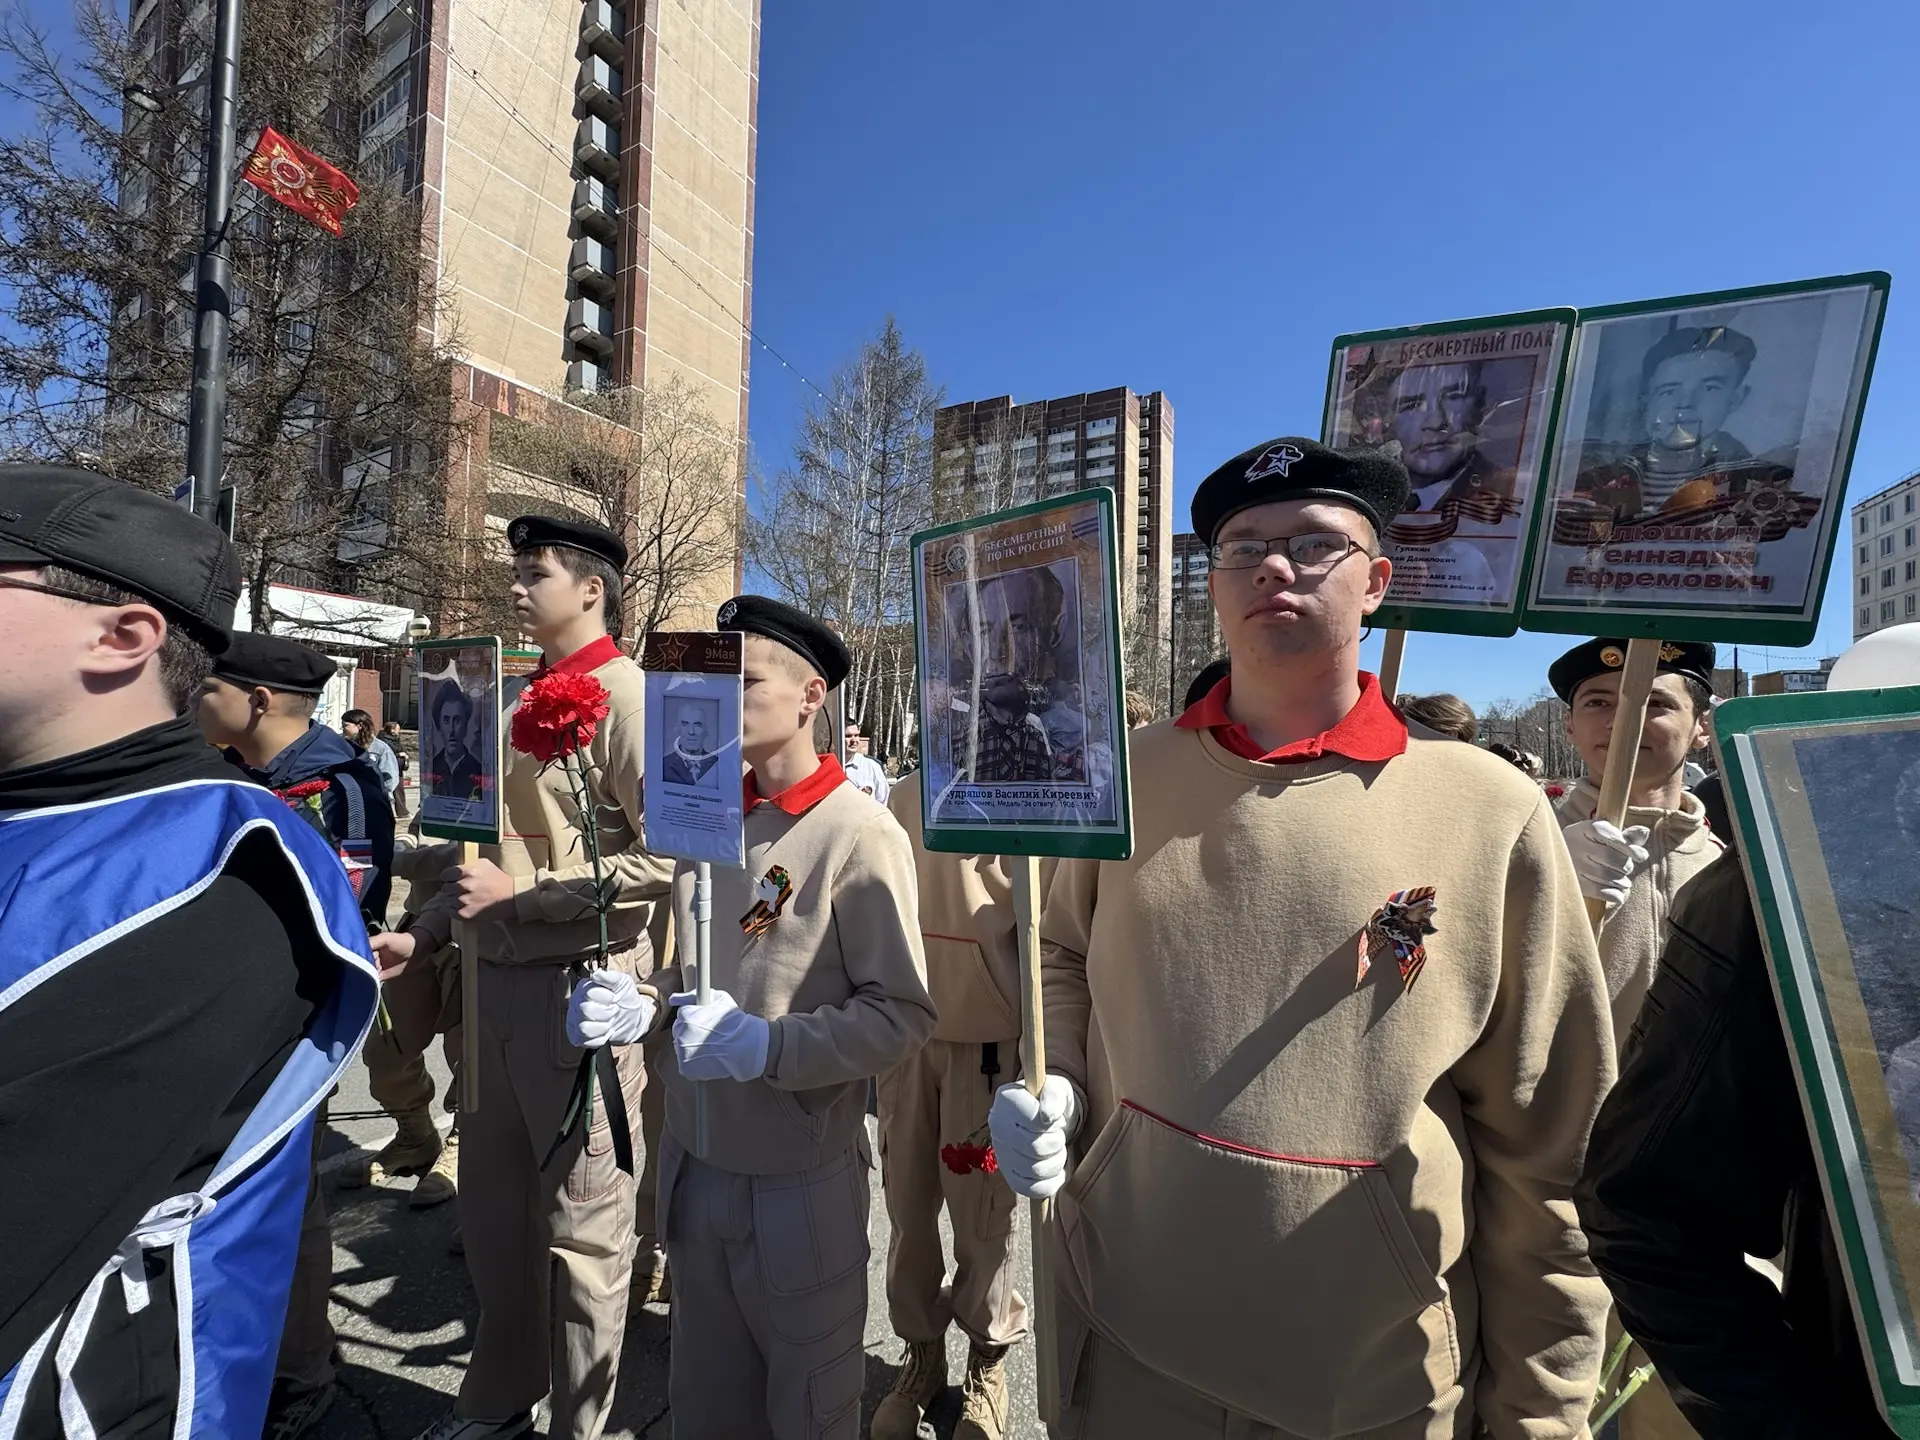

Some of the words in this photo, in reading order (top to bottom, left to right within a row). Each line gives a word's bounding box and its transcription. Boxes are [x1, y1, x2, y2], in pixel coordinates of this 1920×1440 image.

[1400, 331, 1505, 364] БЕССМЕРТНЫЙ
[984, 521, 1067, 552] БЕССМЕРТНЫЙ
[1587, 525, 1761, 542] Илюшкин
[987, 549, 1016, 562] ПОЛК
[1018, 536, 1065, 555] РОССИИ
[1406, 555, 1456, 563] Данилович
[1586, 543, 1757, 567] Геннадий
[1565, 566, 1772, 589] Ефремович
[704, 647, 736, 660] 9Мая
[995, 788, 1040, 799] Василий
[1042, 788, 1099, 801] Киреевич
[1081, 801, 1098, 809] 1972
